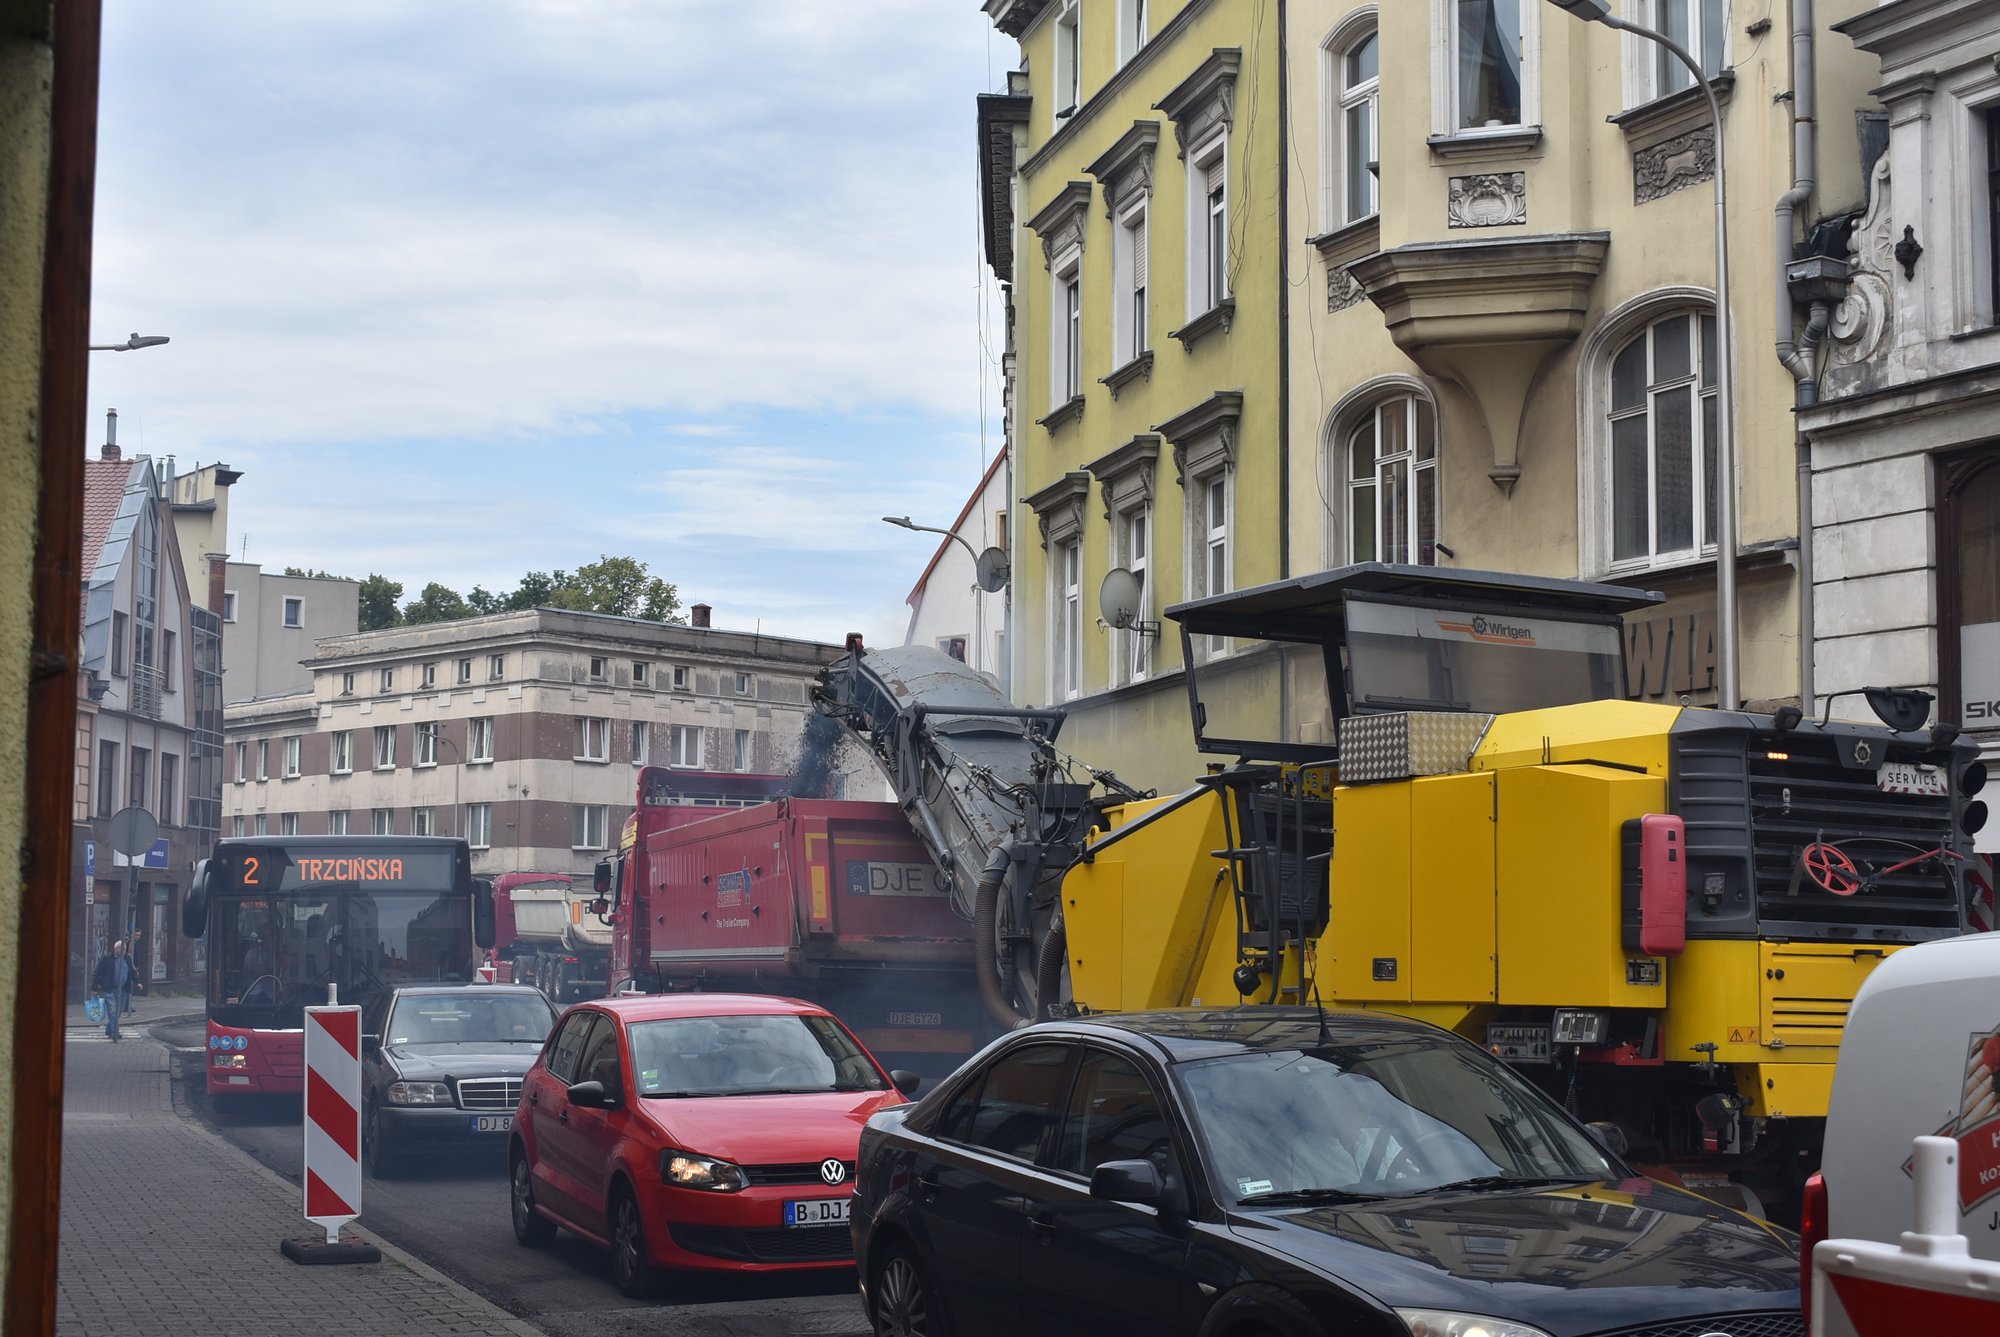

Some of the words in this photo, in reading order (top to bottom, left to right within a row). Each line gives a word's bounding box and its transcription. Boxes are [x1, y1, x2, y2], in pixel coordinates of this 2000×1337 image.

[1489, 622, 1531, 639] Wirtgen
[1888, 772, 1937, 786] SERVICE
[87, 844, 94, 865] P
[243, 857, 259, 884] 2
[298, 857, 403, 881] TRZCIŃSKA
[870, 867, 923, 891] DJE
[480, 1118, 497, 1130] DJ
[502, 1118, 510, 1130] 8
[796, 1204, 808, 1221] B
